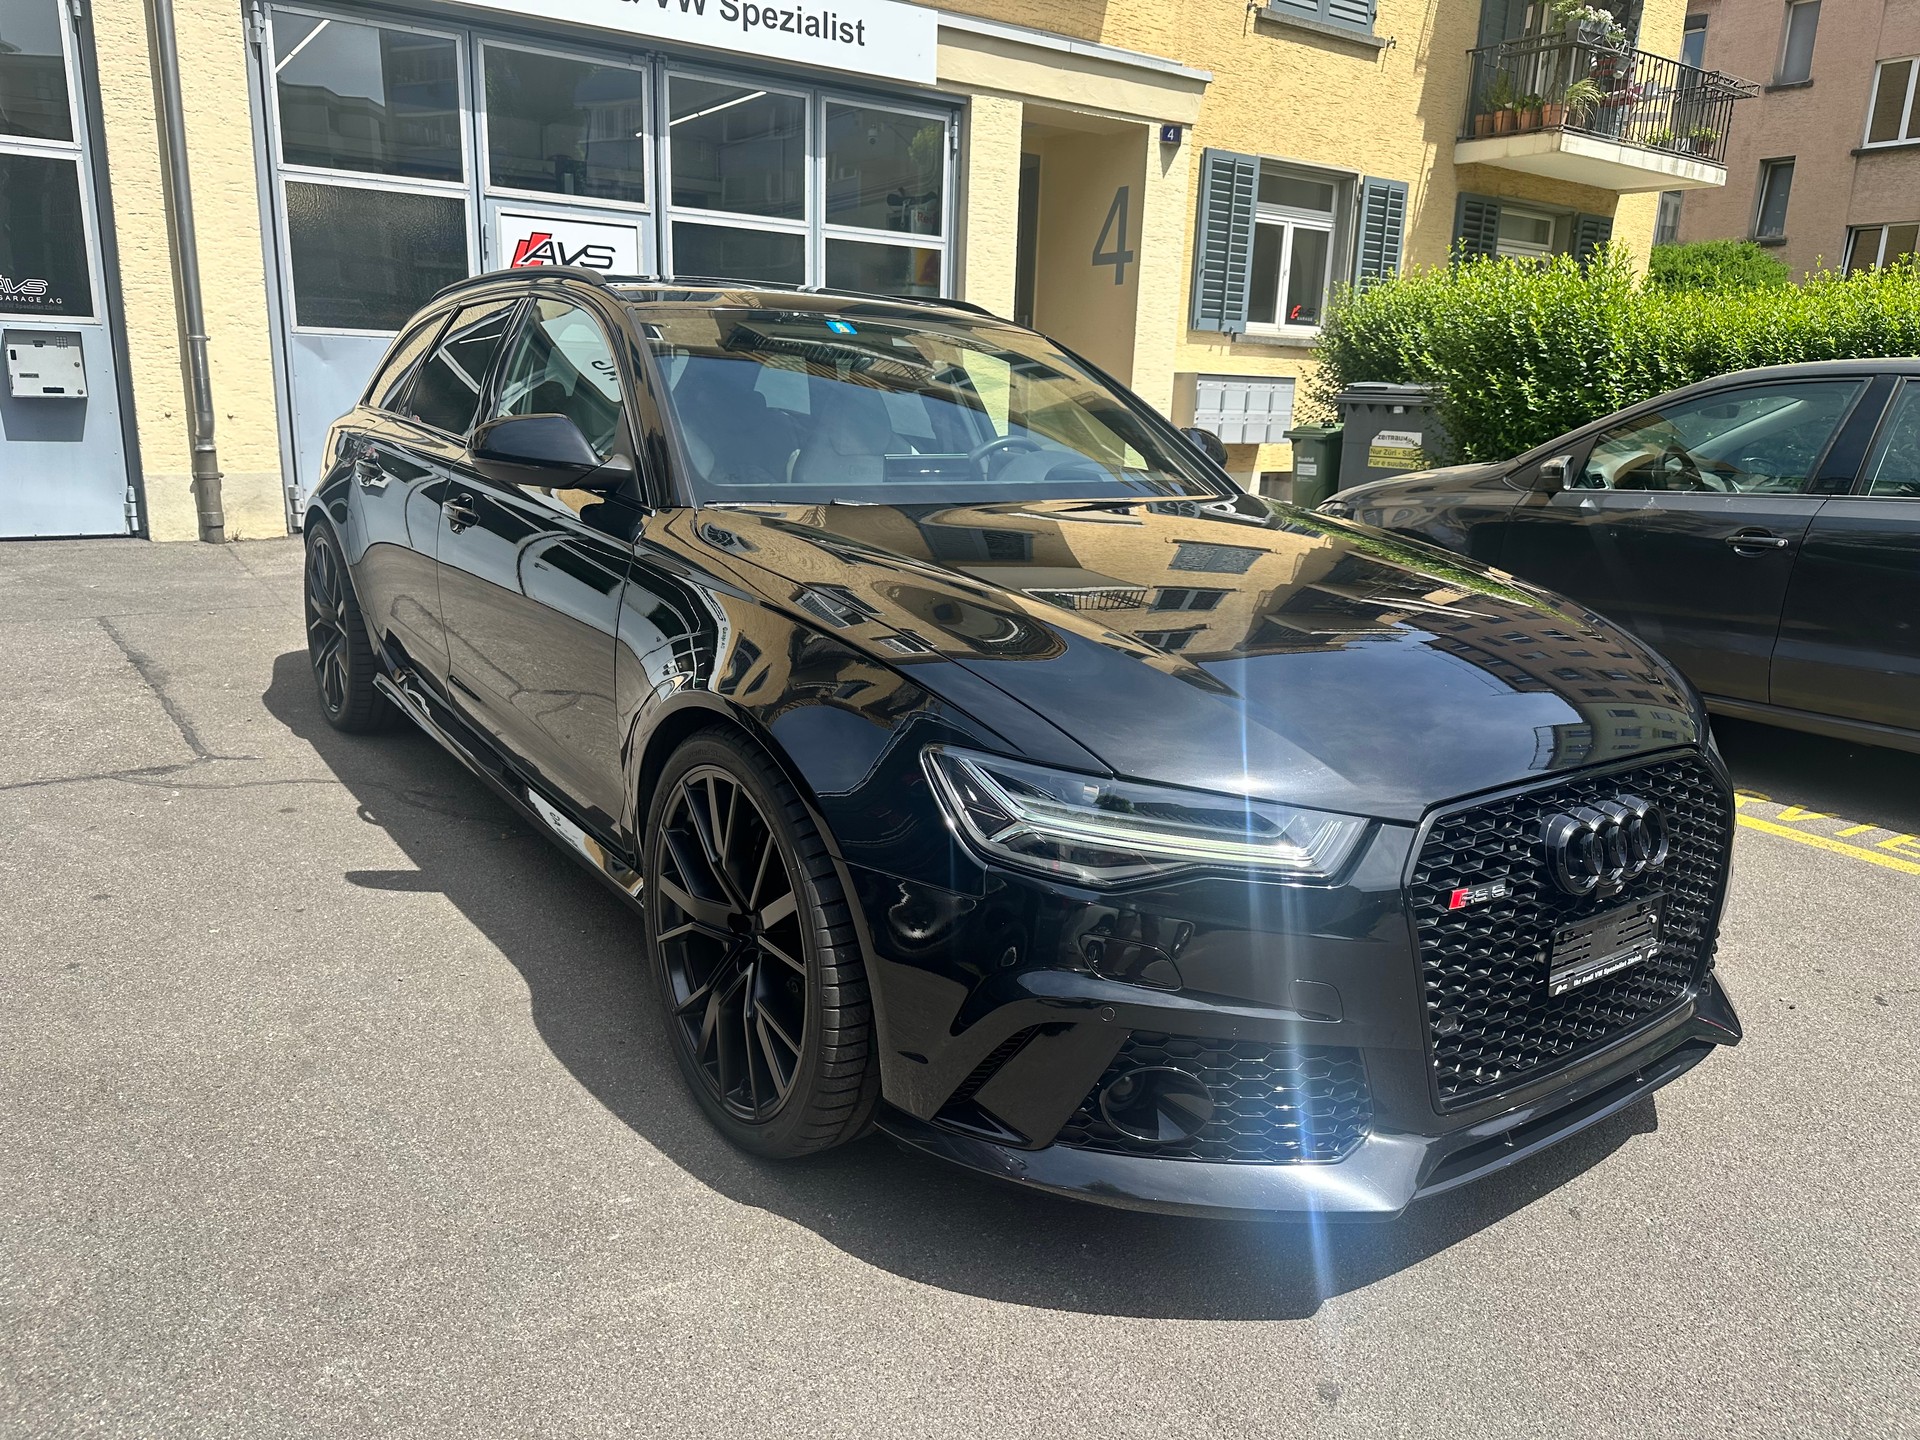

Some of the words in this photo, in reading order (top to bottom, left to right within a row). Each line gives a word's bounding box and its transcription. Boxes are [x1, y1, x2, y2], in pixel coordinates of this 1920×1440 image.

[719, 0, 866, 47] Spezialist
[1167, 128, 1174, 140] 4
[520, 240, 617, 269] AVS
[1092, 185, 1134, 286] 4
